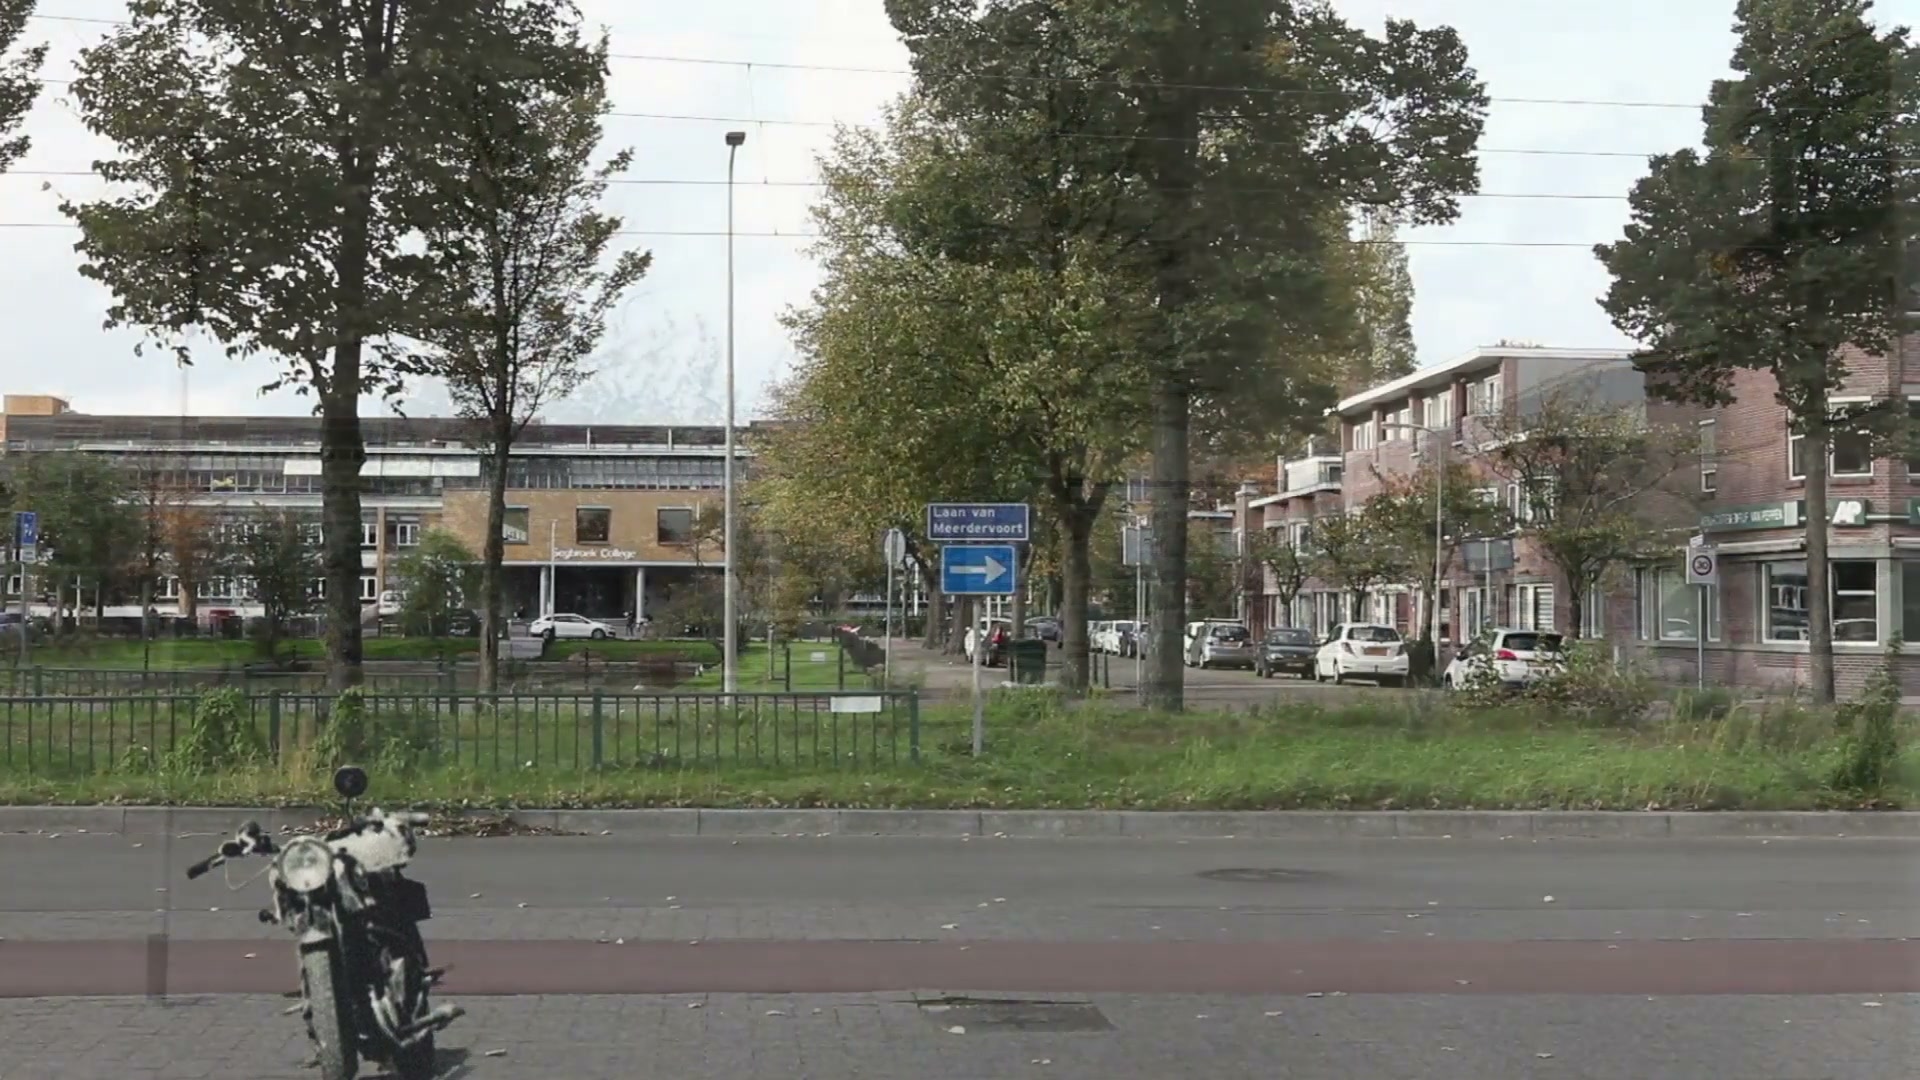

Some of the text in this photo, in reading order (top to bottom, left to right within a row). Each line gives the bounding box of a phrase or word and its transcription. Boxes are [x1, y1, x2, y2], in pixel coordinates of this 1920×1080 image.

[933, 507, 995, 518] Laan van
[933, 522, 1023, 534] Meerdervoort
